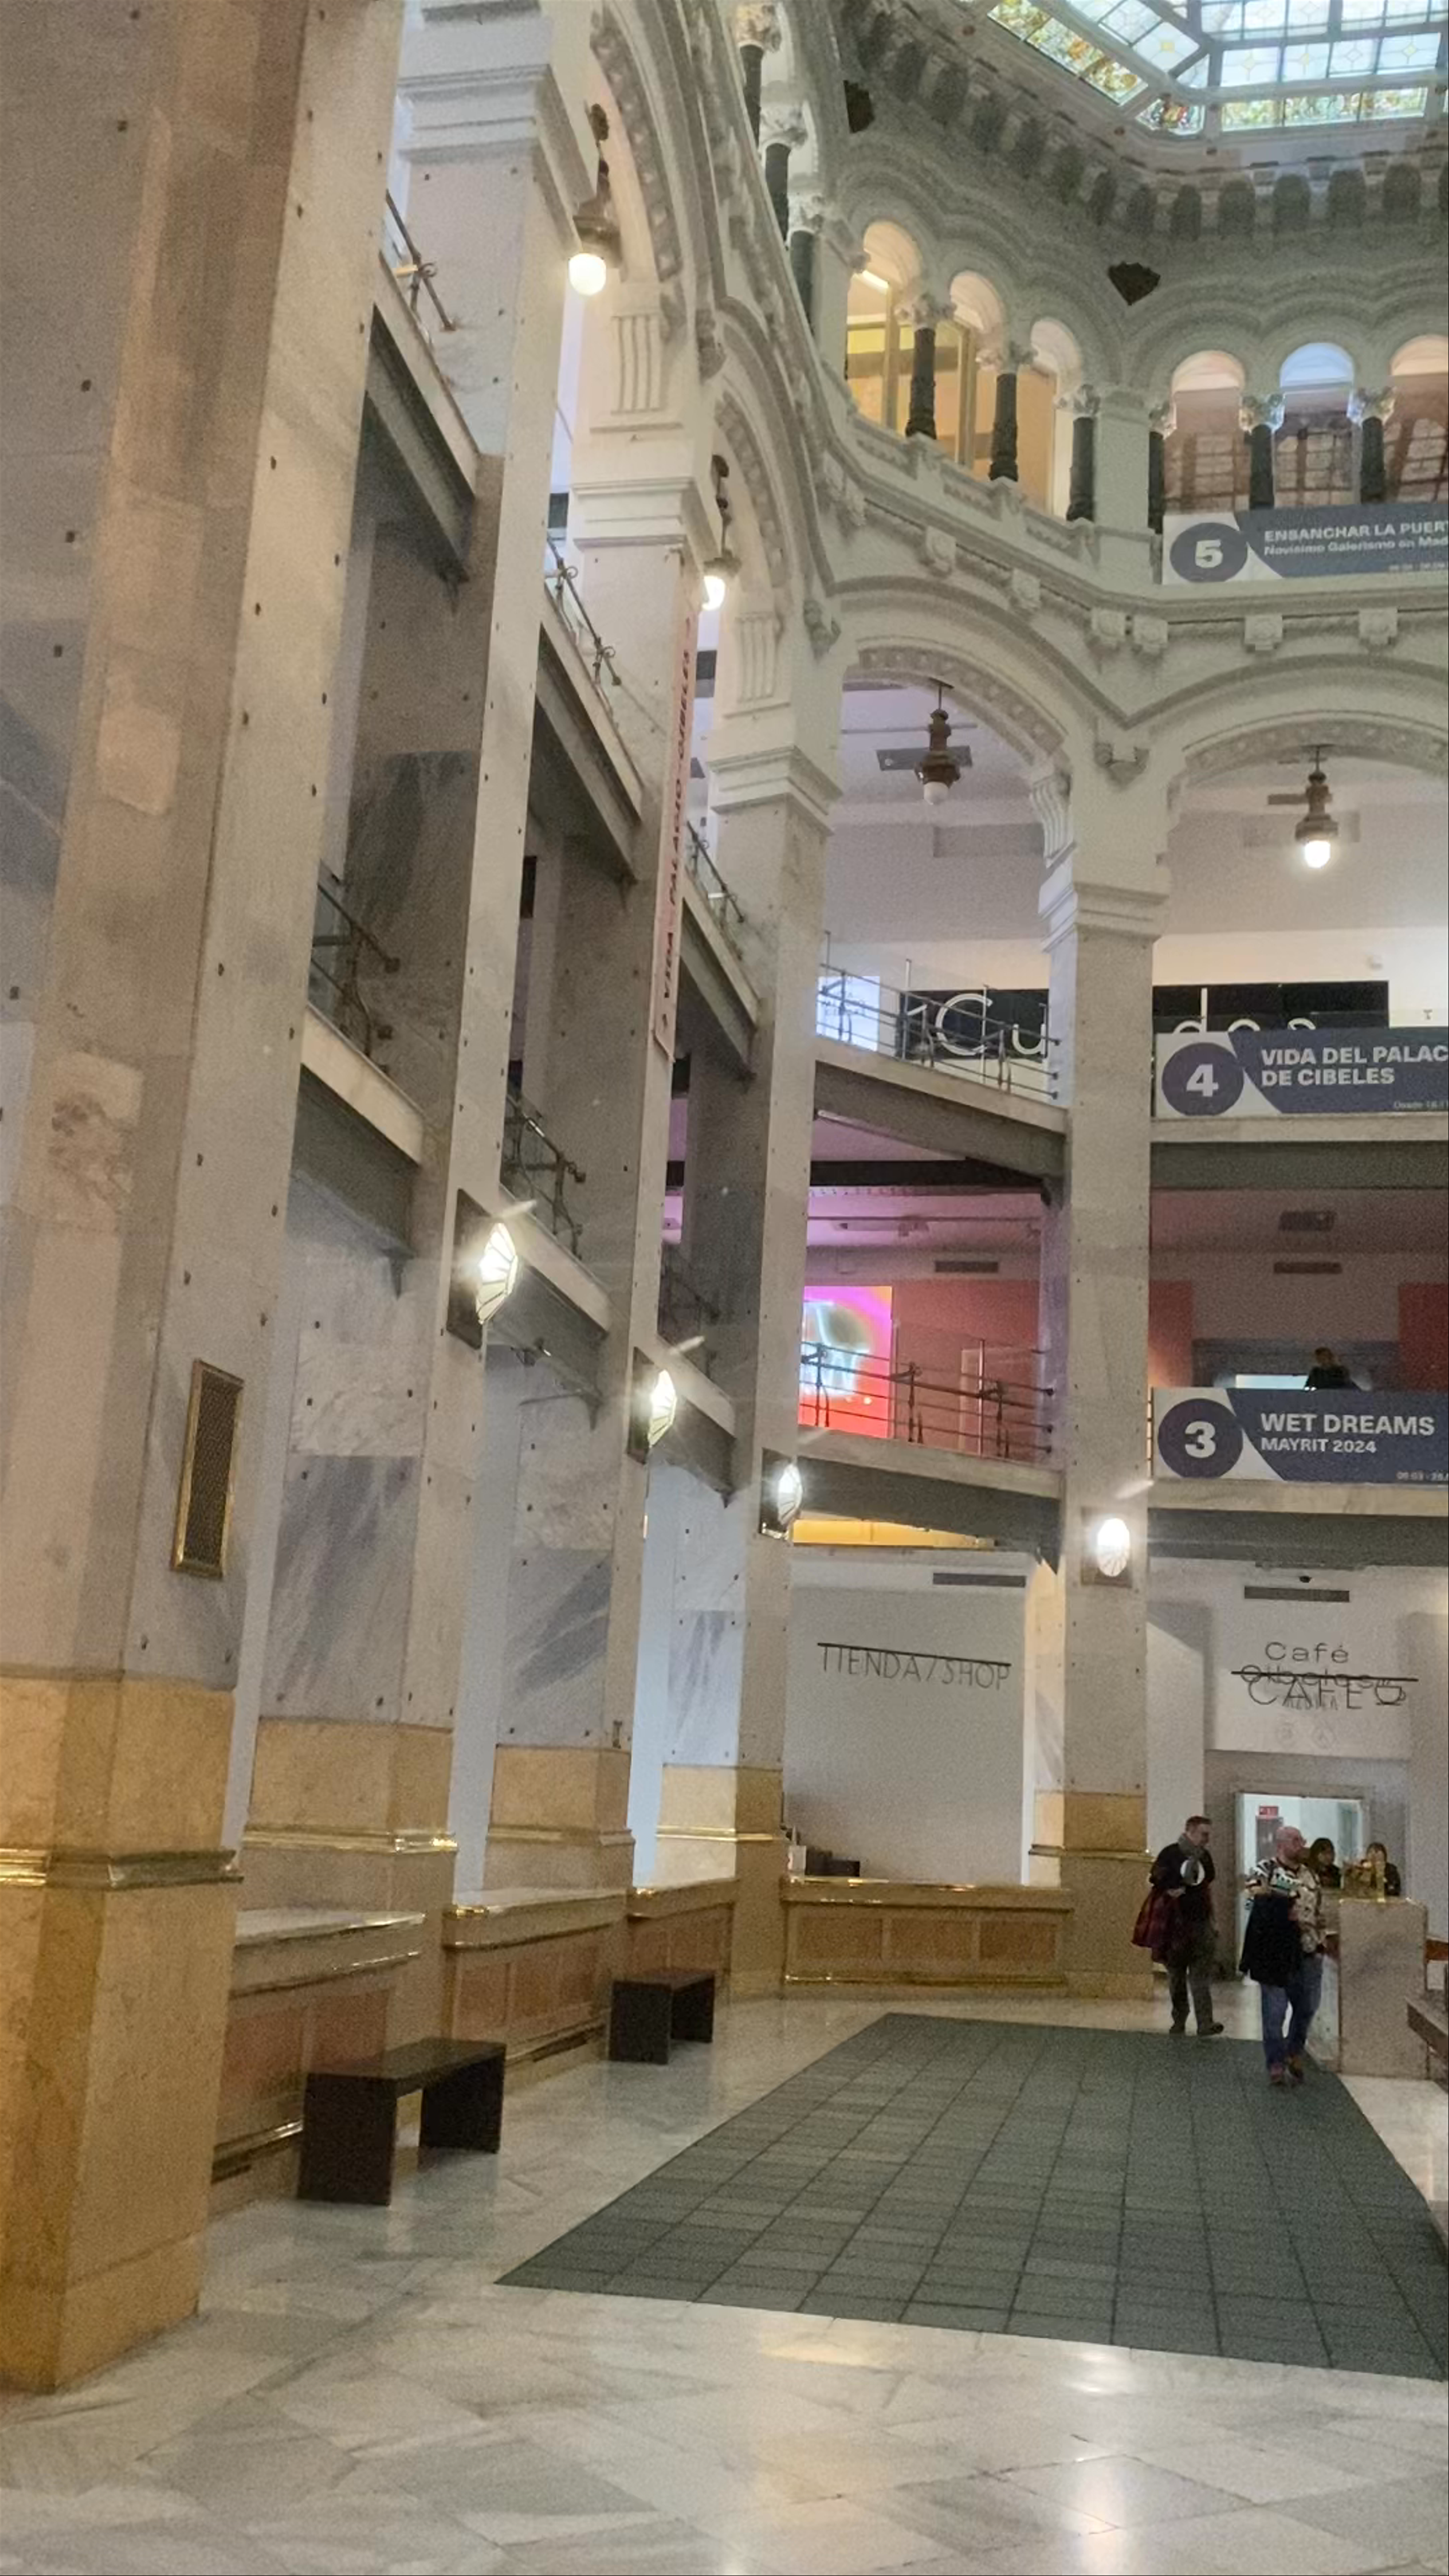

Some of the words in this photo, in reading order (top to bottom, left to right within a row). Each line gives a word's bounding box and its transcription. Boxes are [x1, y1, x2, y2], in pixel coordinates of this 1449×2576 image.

[1264, 525, 1370, 542] ENSANCHAR
[1375, 523, 1396, 536] LA
[1195, 540, 1223, 568] 5
[1261, 1047, 1316, 1066] VIDA
[1322, 1047, 1367, 1064] DEL
[1373, 1046, 1448, 1063] PALAC
[1186, 1064, 1218, 1097] 4
[1262, 1069, 1292, 1086] DE
[1297, 1067, 1395, 1085] CIBELES
[1260, 1413, 1317, 1432] WET
[1323, 1414, 1435, 1436] DREAMS
[1185, 1421, 1216, 1459] 3
[1261, 1437, 1328, 1452] MAYRIT
[1332, 1439, 1377, 1453] 2024
